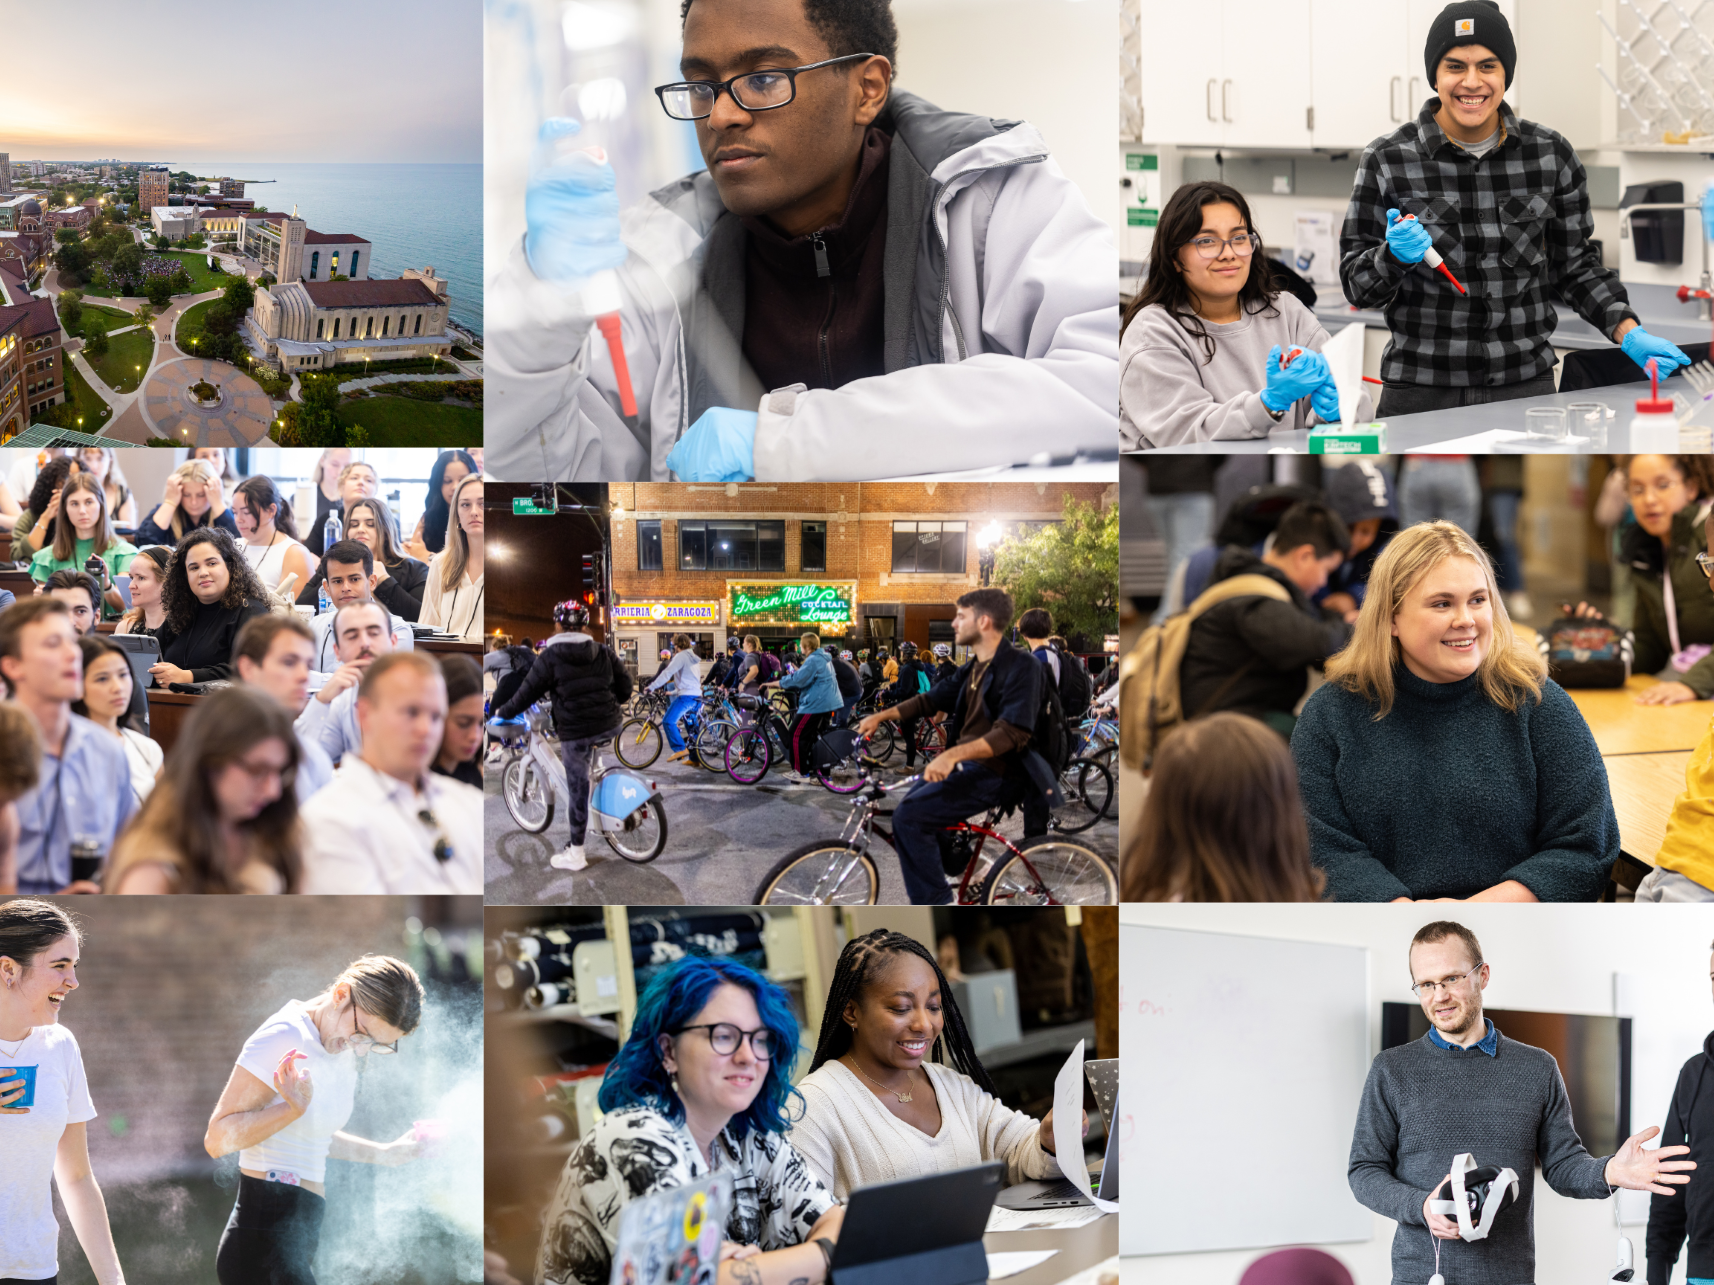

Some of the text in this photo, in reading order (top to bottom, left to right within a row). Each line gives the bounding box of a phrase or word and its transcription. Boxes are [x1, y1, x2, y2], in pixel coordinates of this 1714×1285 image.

[735, 584, 818, 614] Green Mill
[802, 600, 848, 608] COCKTAIL
[667, 607, 712, 617] ZARAGOZA
[801, 599, 847, 624] Lounge
